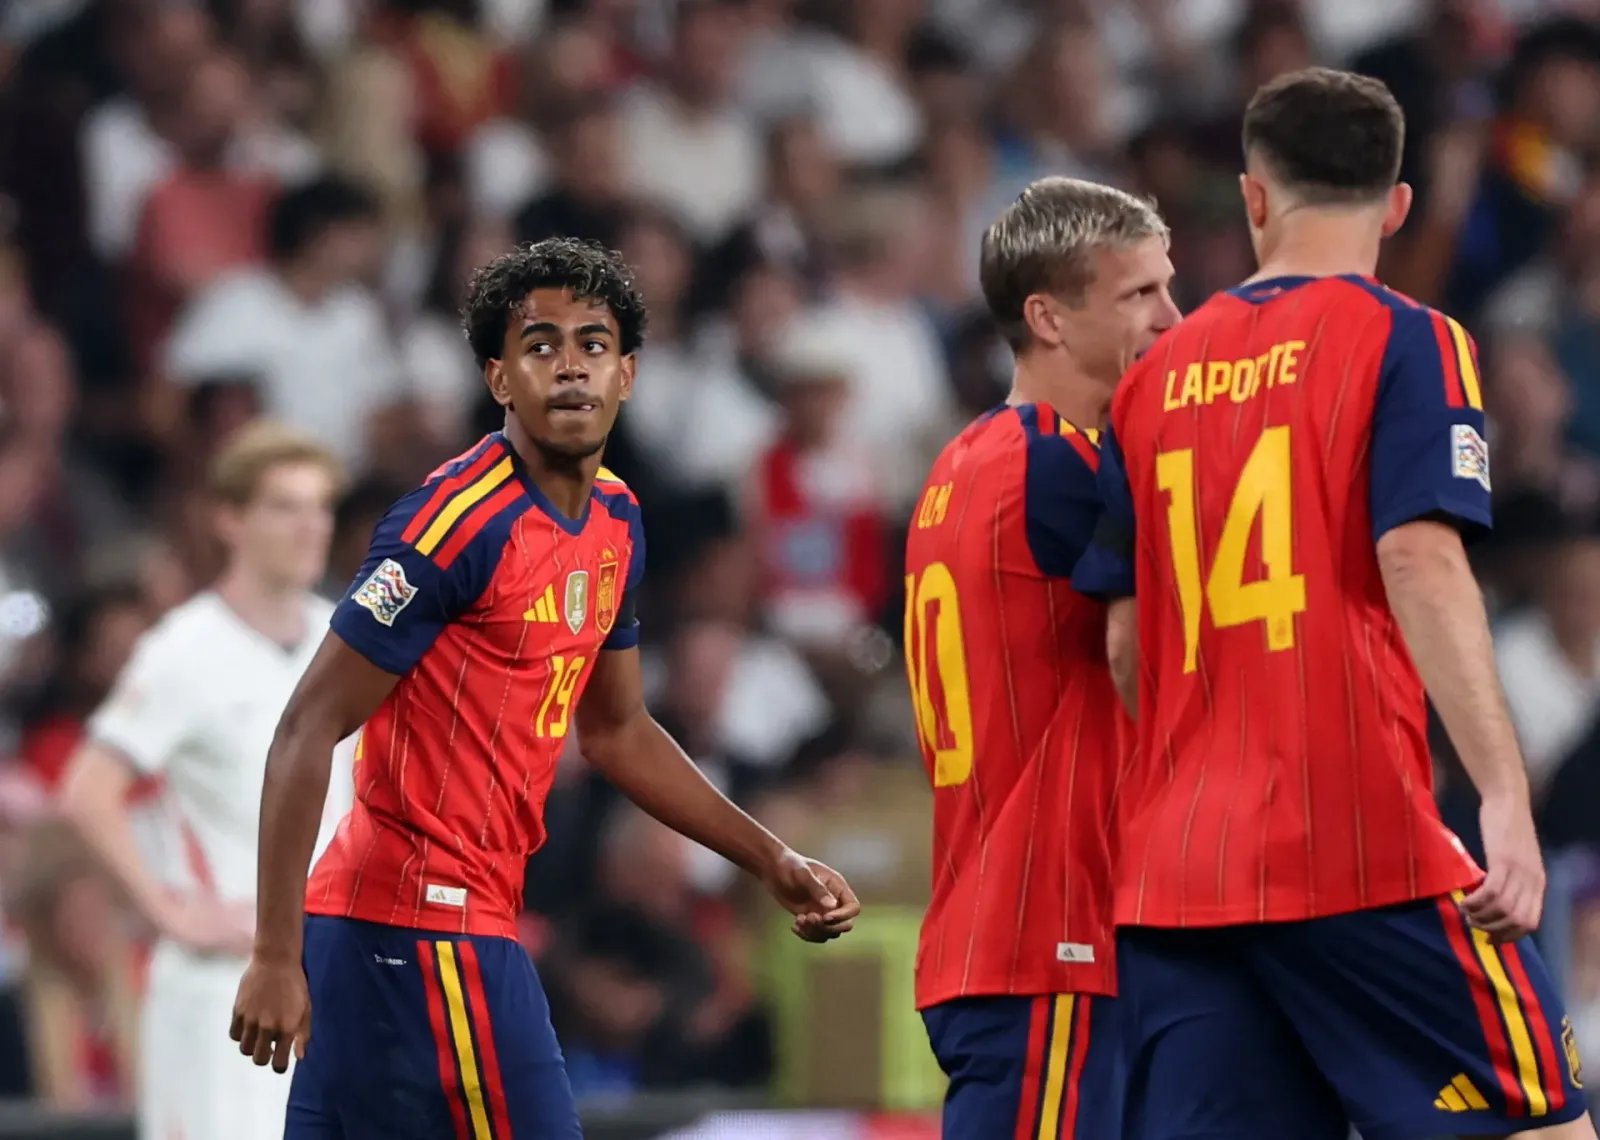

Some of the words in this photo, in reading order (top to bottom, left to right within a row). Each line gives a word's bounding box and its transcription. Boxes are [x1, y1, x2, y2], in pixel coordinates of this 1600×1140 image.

[1156, 425, 1306, 675] 14
[536, 655, 586, 738] 19
[904, 561, 974, 787] 10
